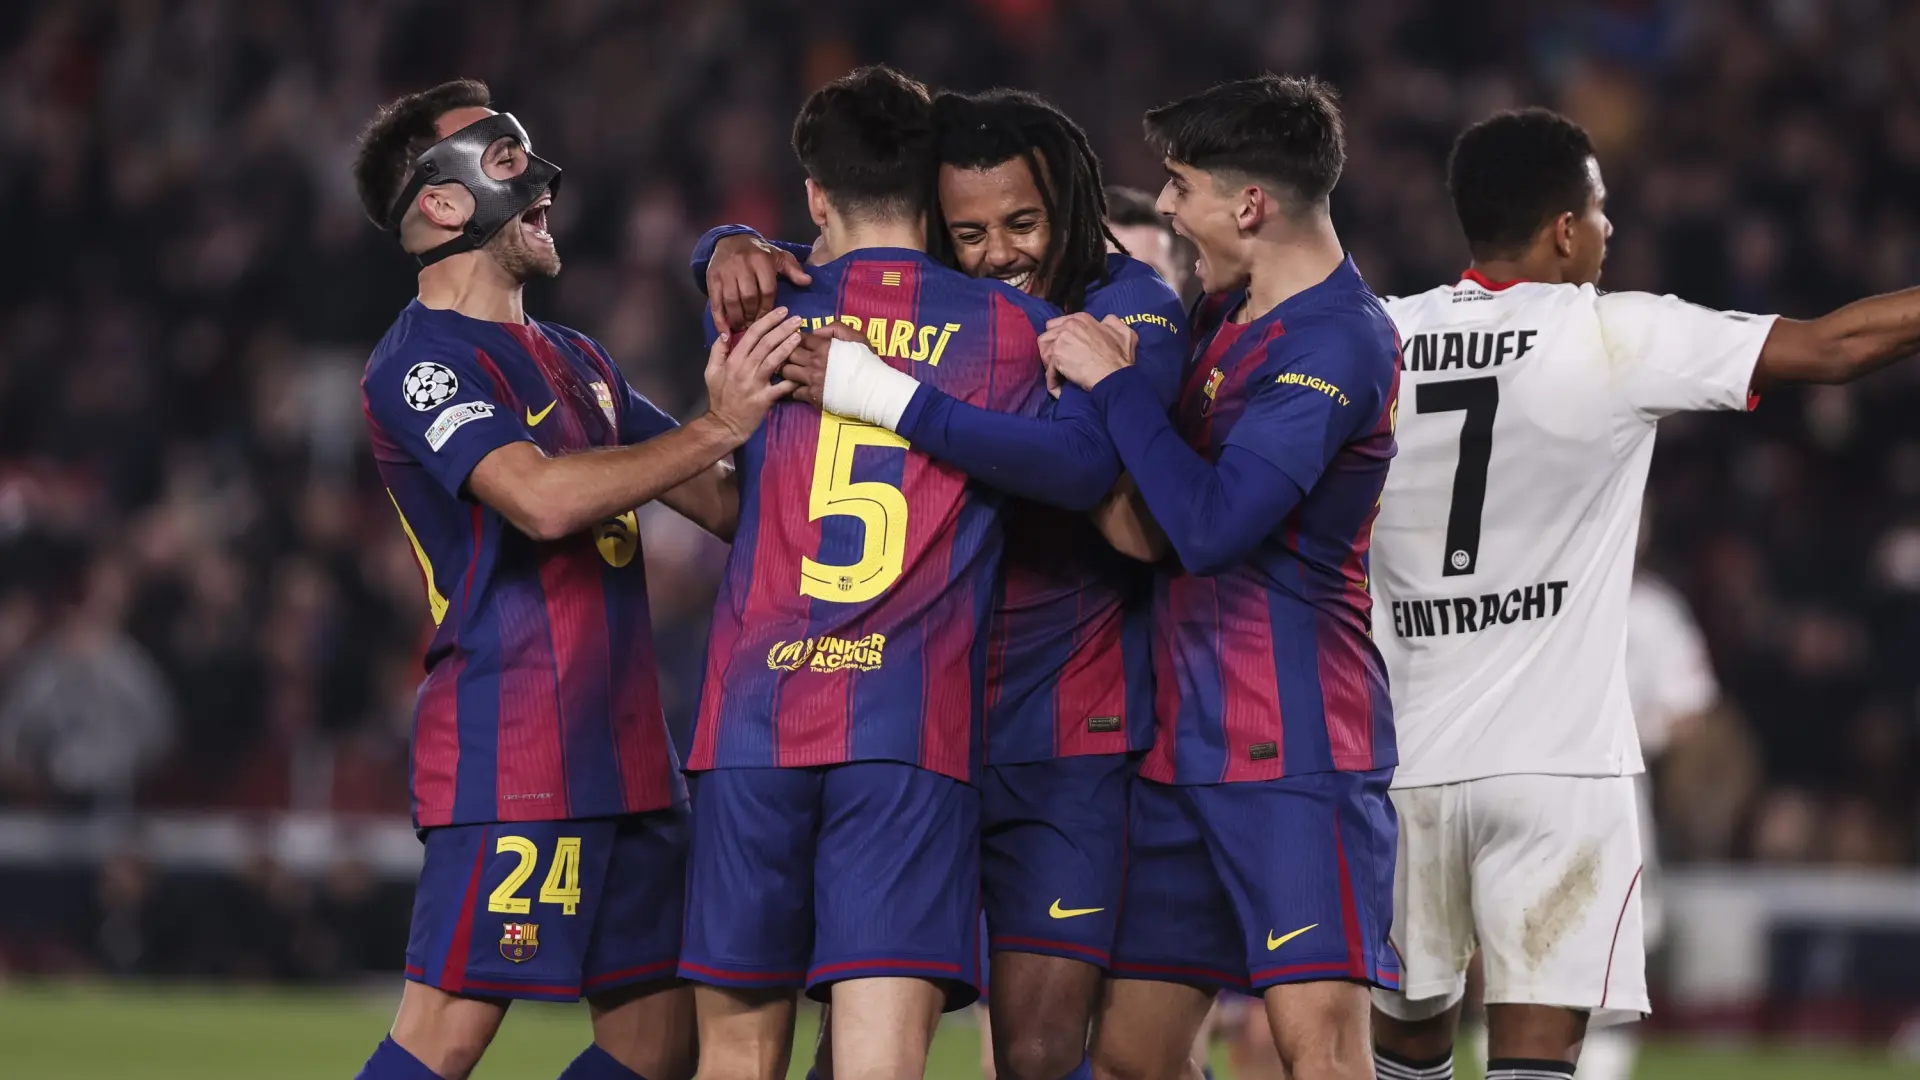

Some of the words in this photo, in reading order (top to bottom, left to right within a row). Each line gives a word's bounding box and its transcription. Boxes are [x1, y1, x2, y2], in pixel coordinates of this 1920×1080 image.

[1169, 322, 1178, 335] tv
[420, 374, 438, 394] 5
[1275, 372, 1340, 397] MBILIGHT
[1338, 393, 1351, 407] tv
[1416, 375, 1500, 578] 7
[799, 410, 911, 604] 5
[1391, 580, 1569, 638] EINTRACHT
[488, 835, 582, 915] 24
